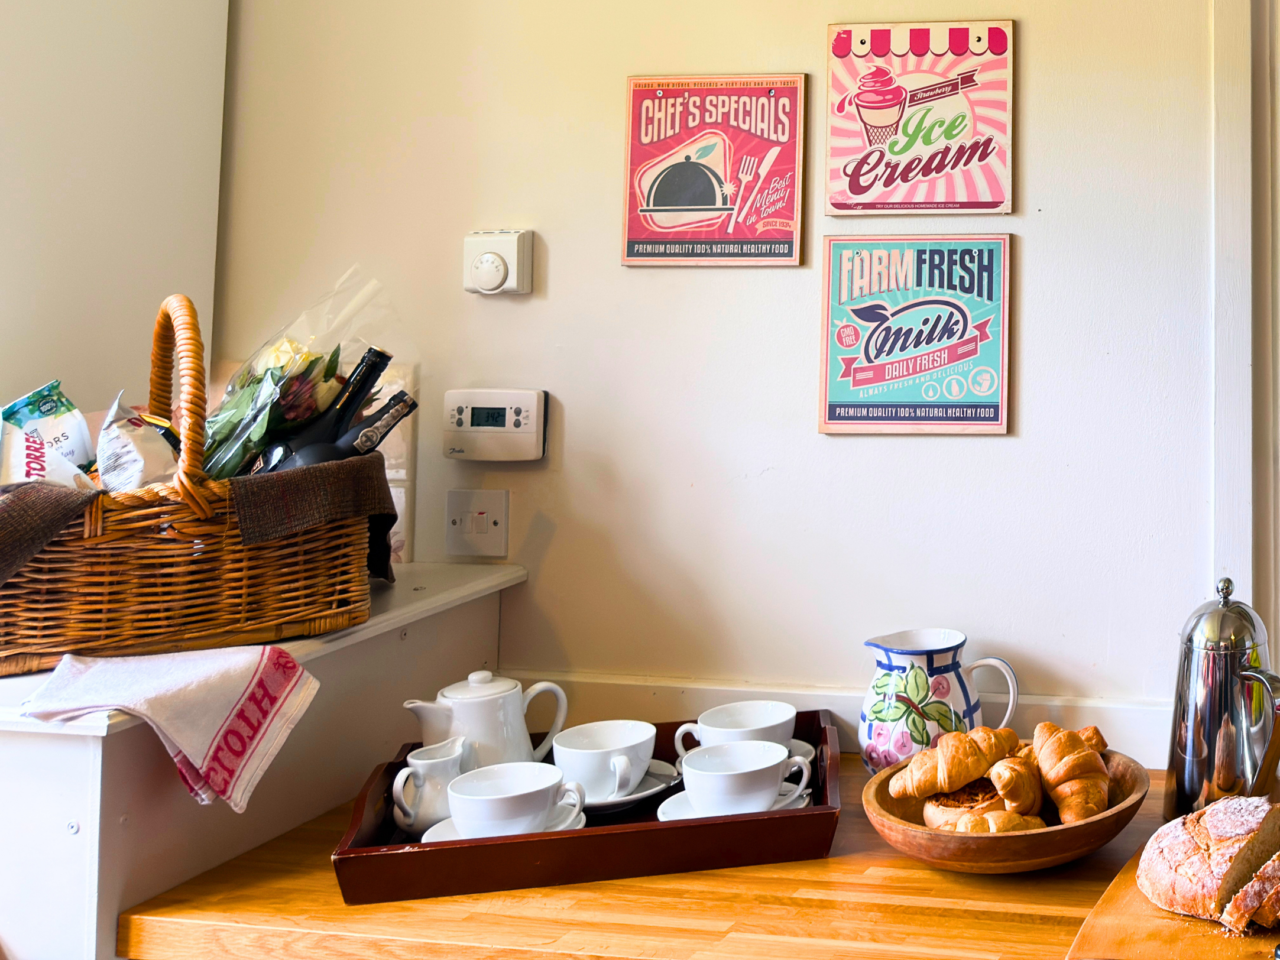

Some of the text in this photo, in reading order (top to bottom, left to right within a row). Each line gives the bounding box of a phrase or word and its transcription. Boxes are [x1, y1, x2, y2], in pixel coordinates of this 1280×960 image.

[914, 85, 953, 101] Strawberry
[640, 91, 791, 144] CHEF'S SPECIALS
[888, 105, 968, 156] Ice
[842, 134, 997, 196] Cream
[768, 171, 794, 194] Best
[746, 188, 790, 226] in town!
[751, 188, 786, 213] Menu
[634, 243, 789, 254] PREMIUM QUALITY 100% NATURAL HEALTHY FOOD
[839, 248, 994, 305] FARM FRESH
[840, 326, 855, 338] GMO
[842, 335, 857, 346] FREE
[873, 310, 961, 360] milk
[859, 360, 974, 399] ALWAYS FRESH AND DELICIOUS
[885, 348, 949, 380] DAILY FRESH
[835, 407, 995, 418] PREMIUM QUALITY 100% NATURAL HEALTHY FOOD
